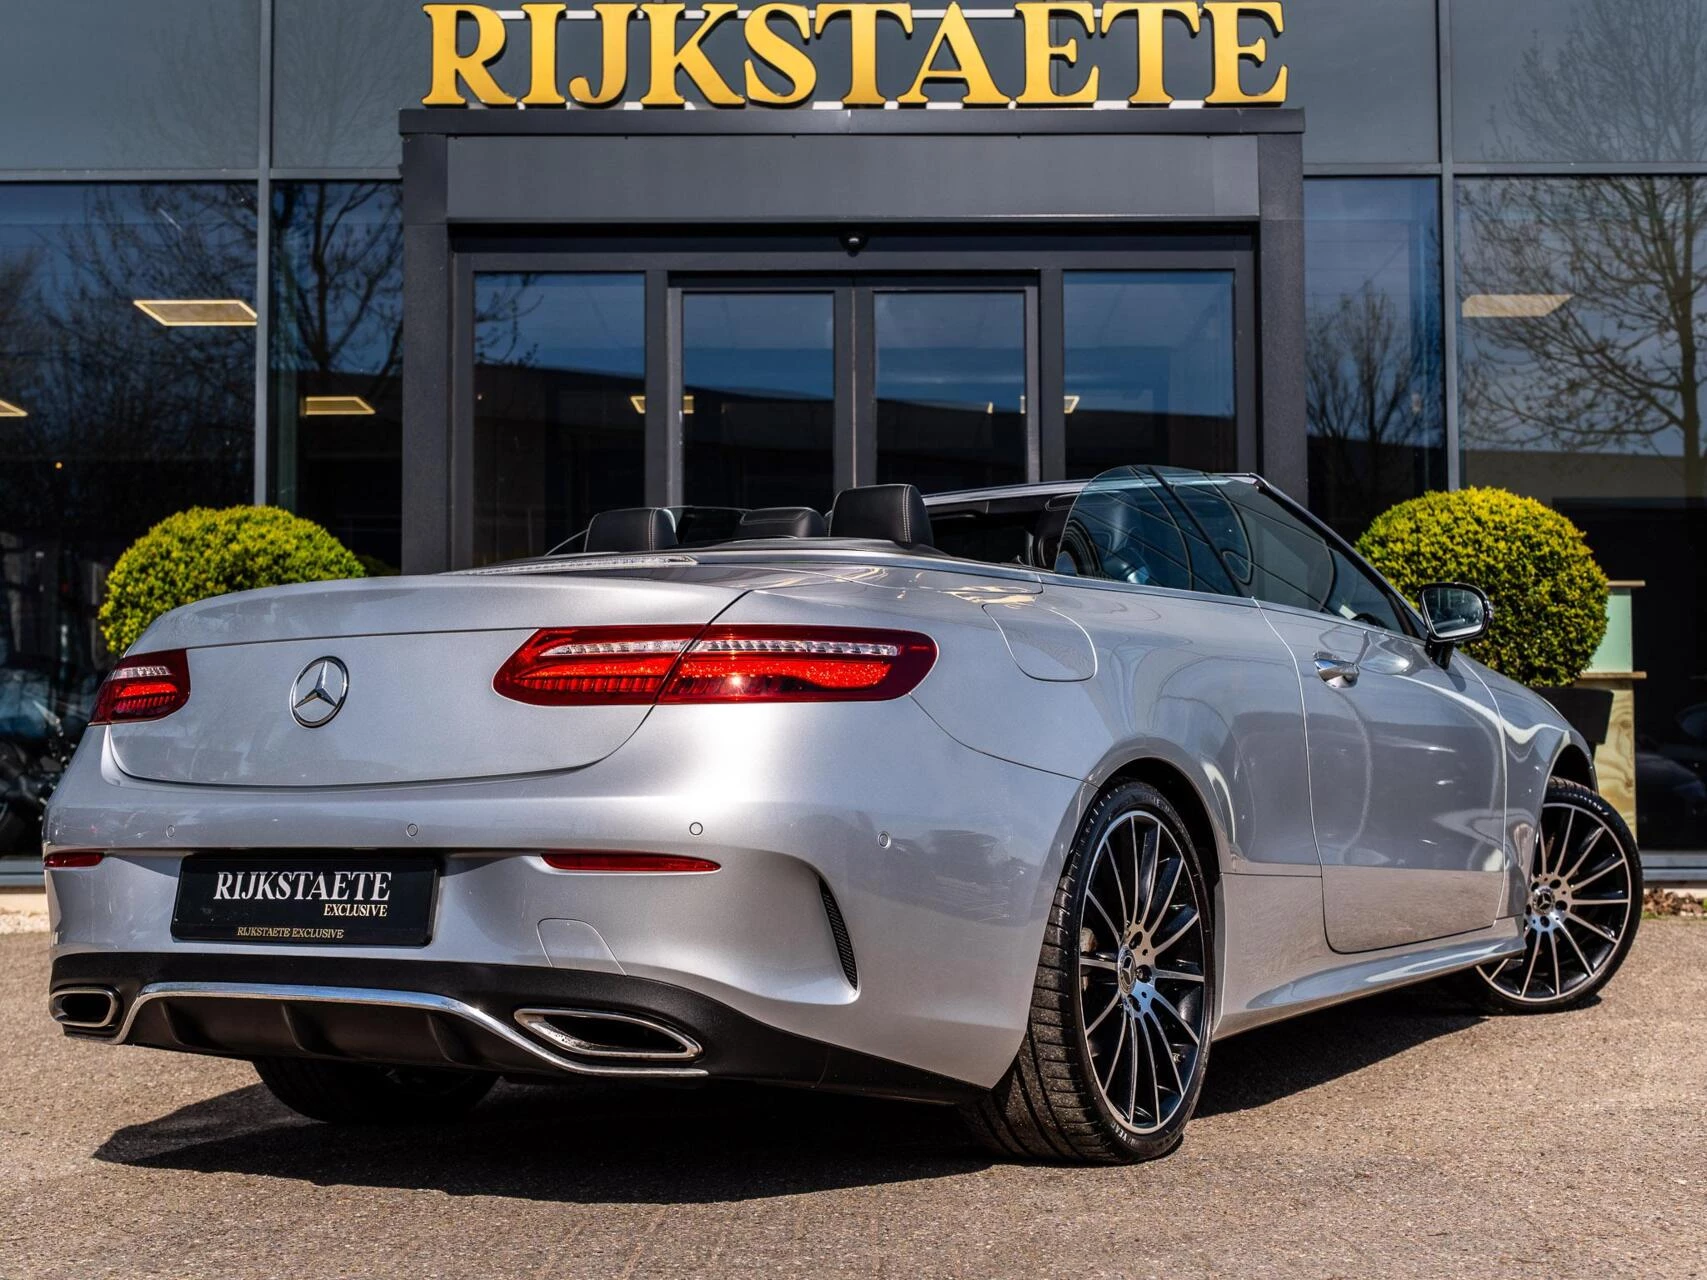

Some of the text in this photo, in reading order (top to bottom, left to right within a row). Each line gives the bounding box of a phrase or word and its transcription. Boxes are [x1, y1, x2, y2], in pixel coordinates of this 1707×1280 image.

[421, 1, 1289, 107] RIJKSTAETE
[213, 871, 392, 901] RIJKSTAETE
[323, 903, 388, 917] EXCLUSIVE
[237, 926, 344, 939] RIJKSTAETE EXCLUSIVE
